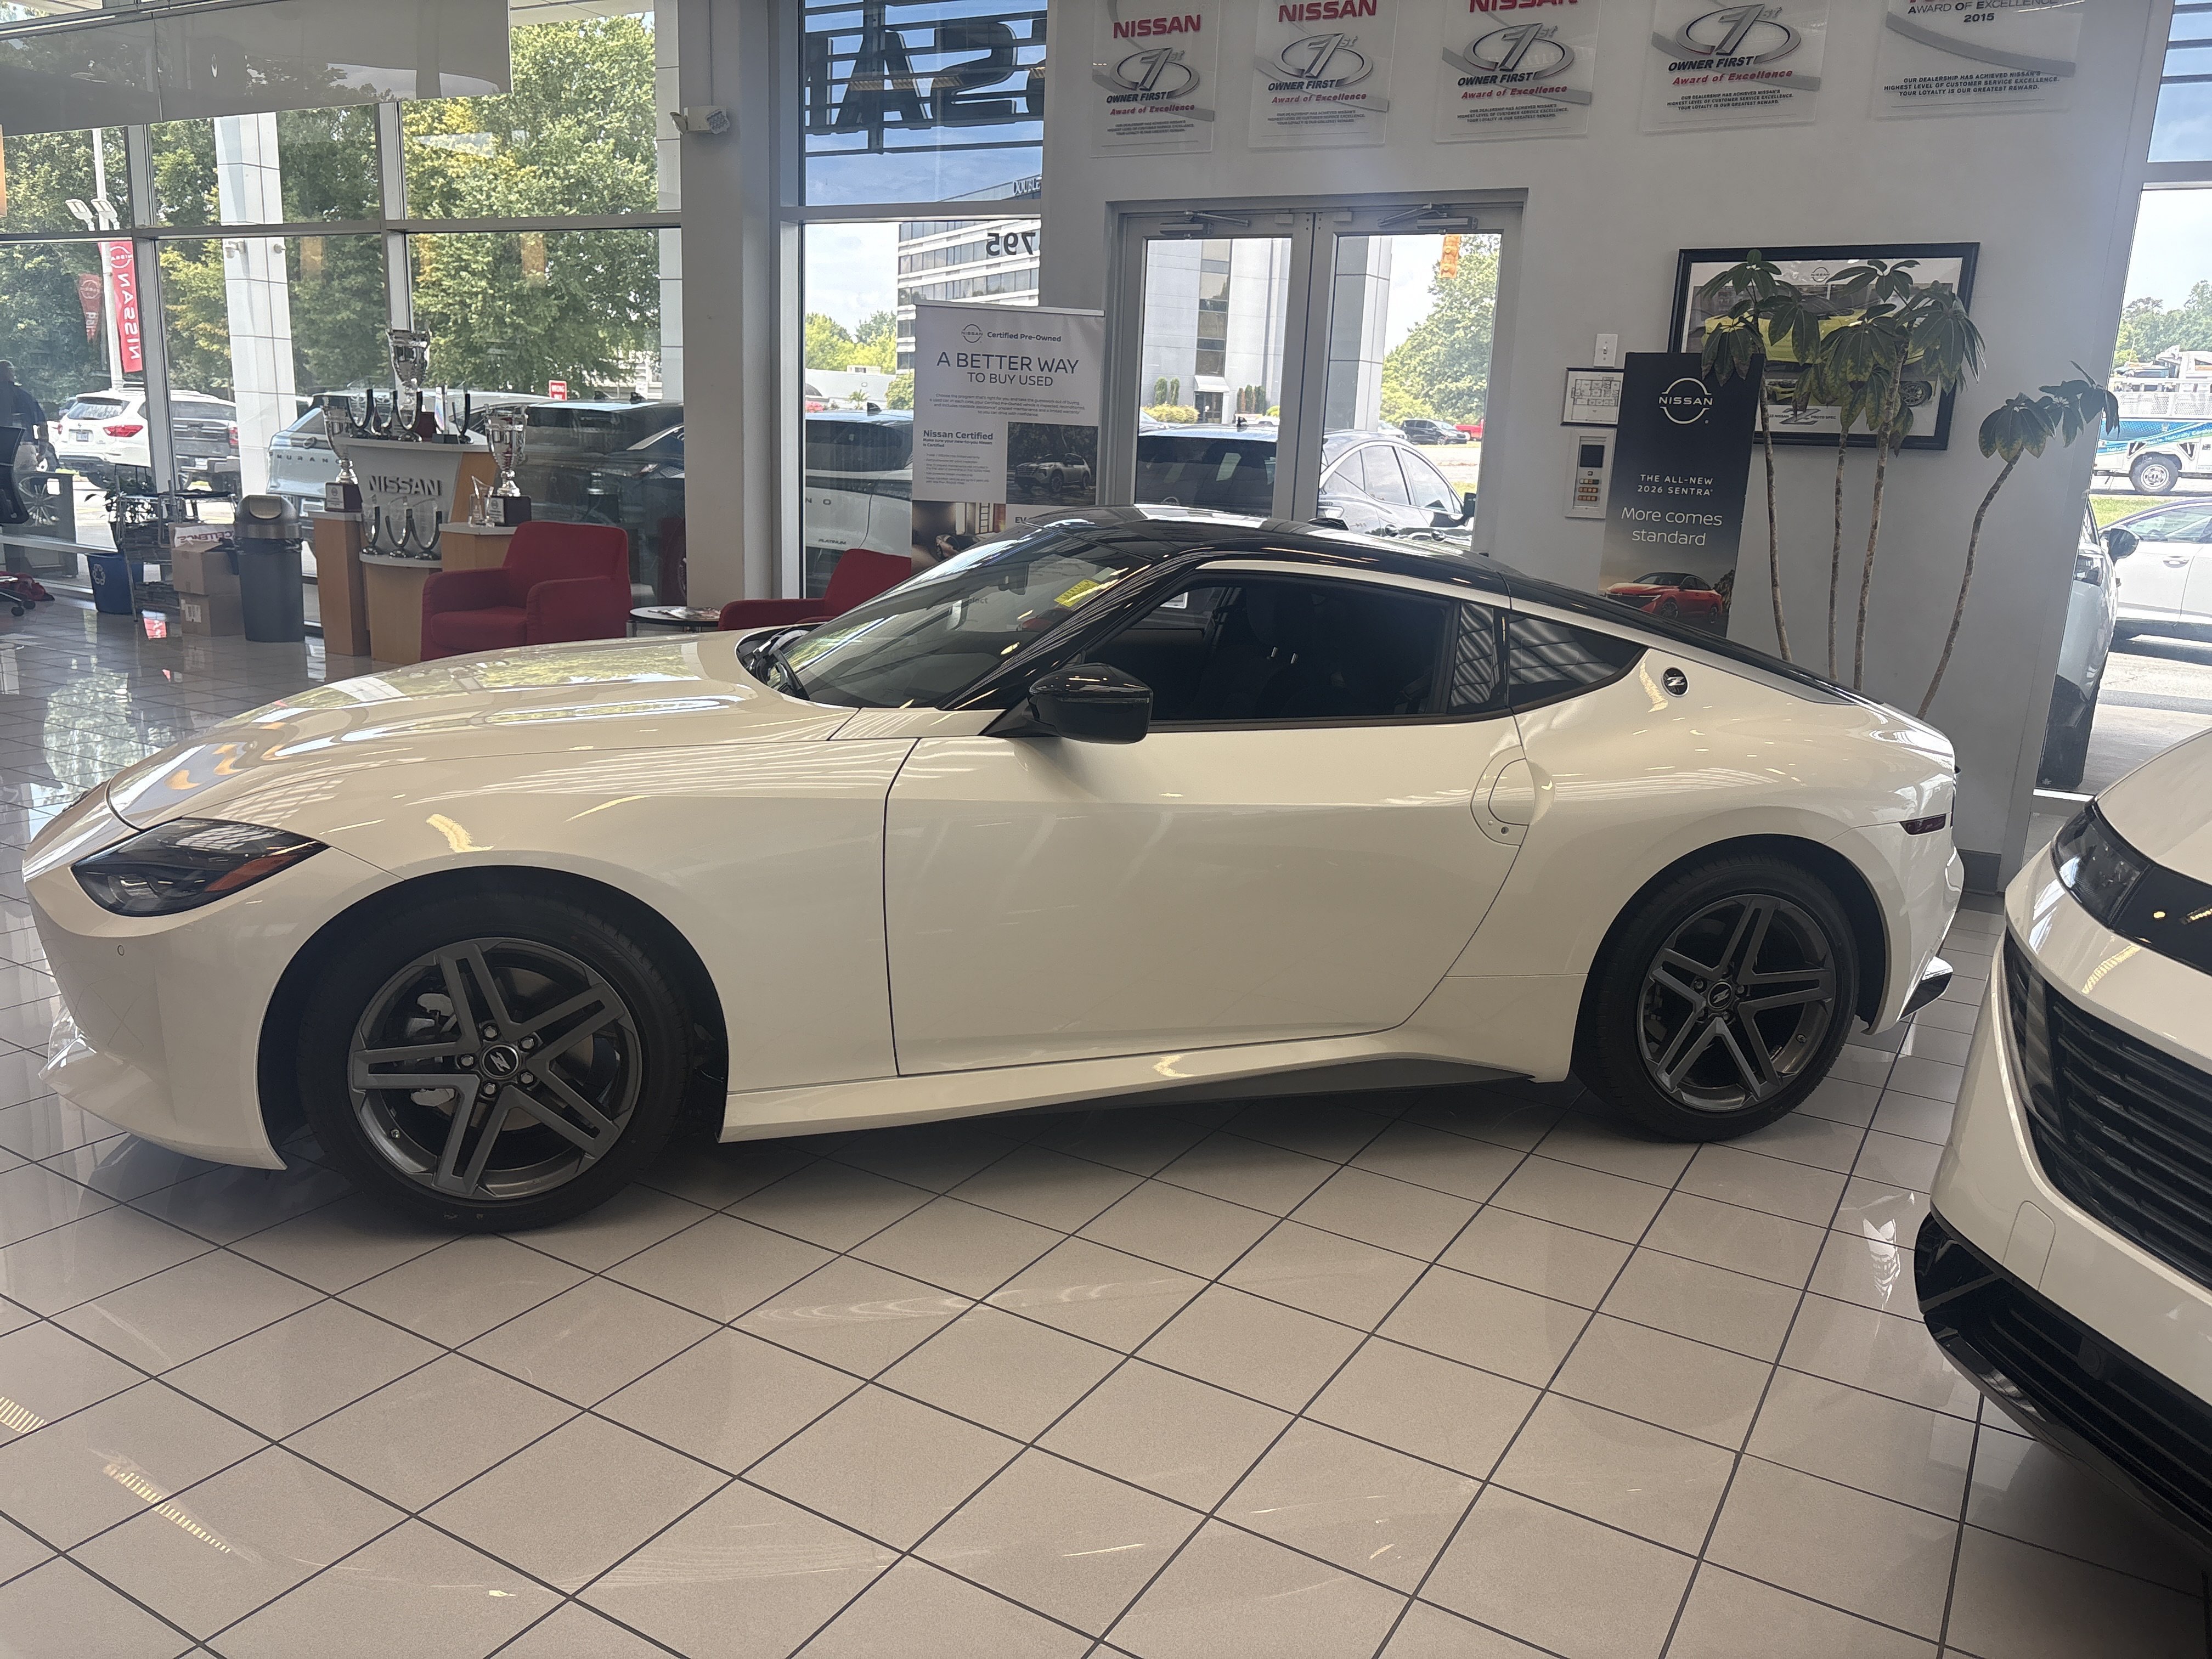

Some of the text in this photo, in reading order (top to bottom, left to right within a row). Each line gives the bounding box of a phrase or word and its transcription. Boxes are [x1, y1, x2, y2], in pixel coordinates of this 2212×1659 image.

[1278, 0, 1377, 22] NISSAN
[1908, 3, 1951, 15] AWARD
[1955, 2, 1972, 11] OF
[1963, 13, 1995, 23] 2015
[1113, 14, 1201, 38] NISSAN
[1668, 57, 1754, 71] OWNER FIRST
[1458, 72, 1534, 86] OWNER FIRST
[1672, 70, 1793, 85] Award of Excellence
[1268, 79, 1336, 92] OWNER FIRST
[1106, 91, 1167, 103] OWNER FIRST
[1272, 95, 1300, 103] Award
[1461, 89, 1493, 99] Award
[1510, 86, 1567, 95] Excellence
[1109, 104, 1195, 115] Award of Excellence
[987, 331, 1019, 340] Certified
[1020, 333, 1062, 342] Pre-Owned
[936, 352, 1079, 374] A BETTER WAY
[966, 372, 1053, 387] TO BUY USED
[1658, 396, 1713, 406] NISSAN
[923, 430, 994, 440] Nissan Certified
[369, 473, 442, 496] NISSAN
[1640, 474, 1713, 486] THE ALL-NEW
[1637, 484, 1663, 494] 2026
[1620, 506, 1723, 527] More comes
[1631, 527, 1706, 547] standard
